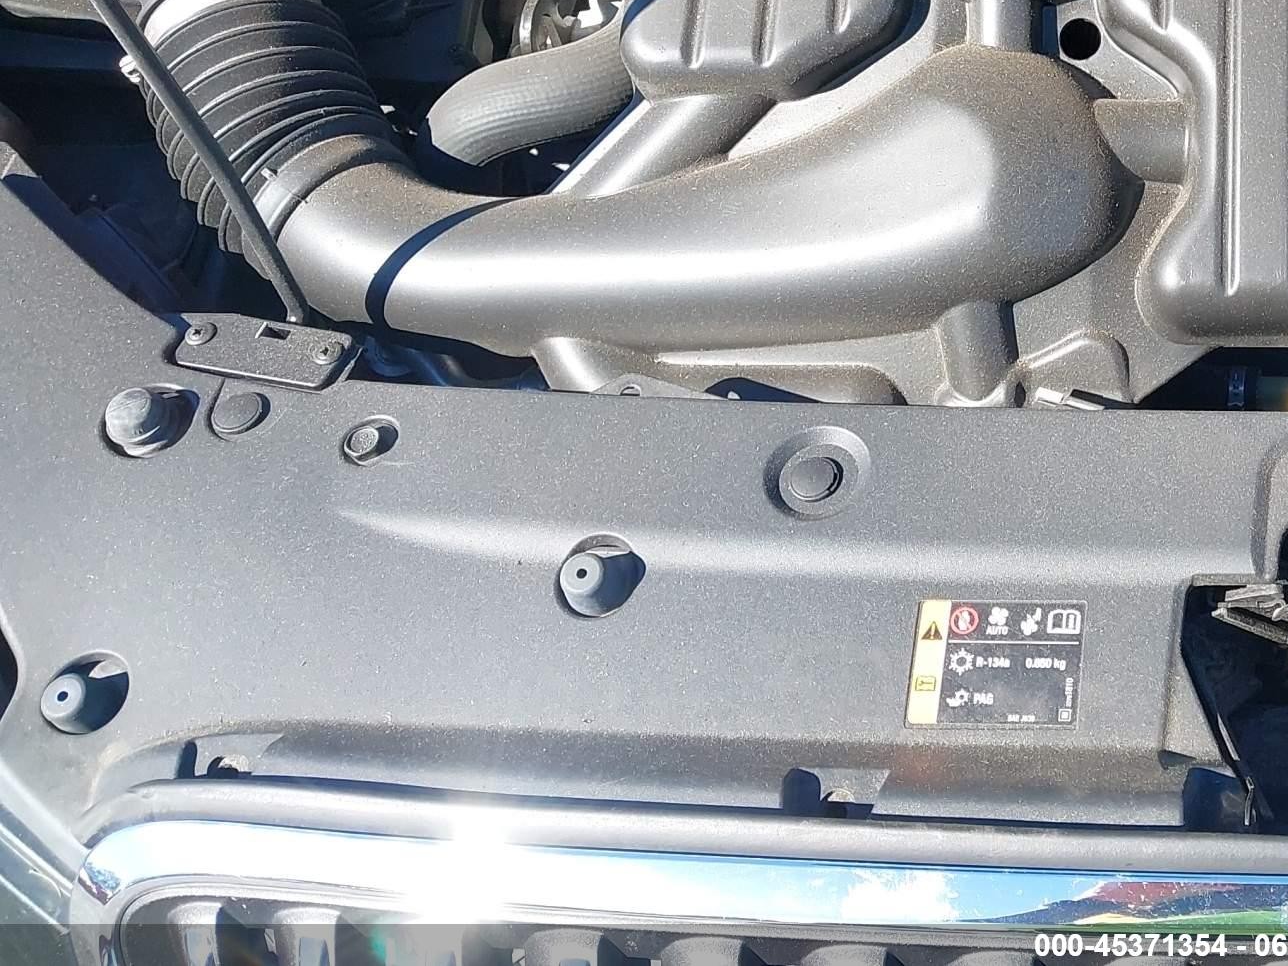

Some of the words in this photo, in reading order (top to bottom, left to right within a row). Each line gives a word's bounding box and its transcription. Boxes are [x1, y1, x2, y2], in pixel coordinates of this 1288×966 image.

[986, 625, 1009, 635] AUTO
[976, 656, 1010, 668] R-134a
[1053, 657, 1066, 671] kg
[973, 693, 994, 705] PAG
